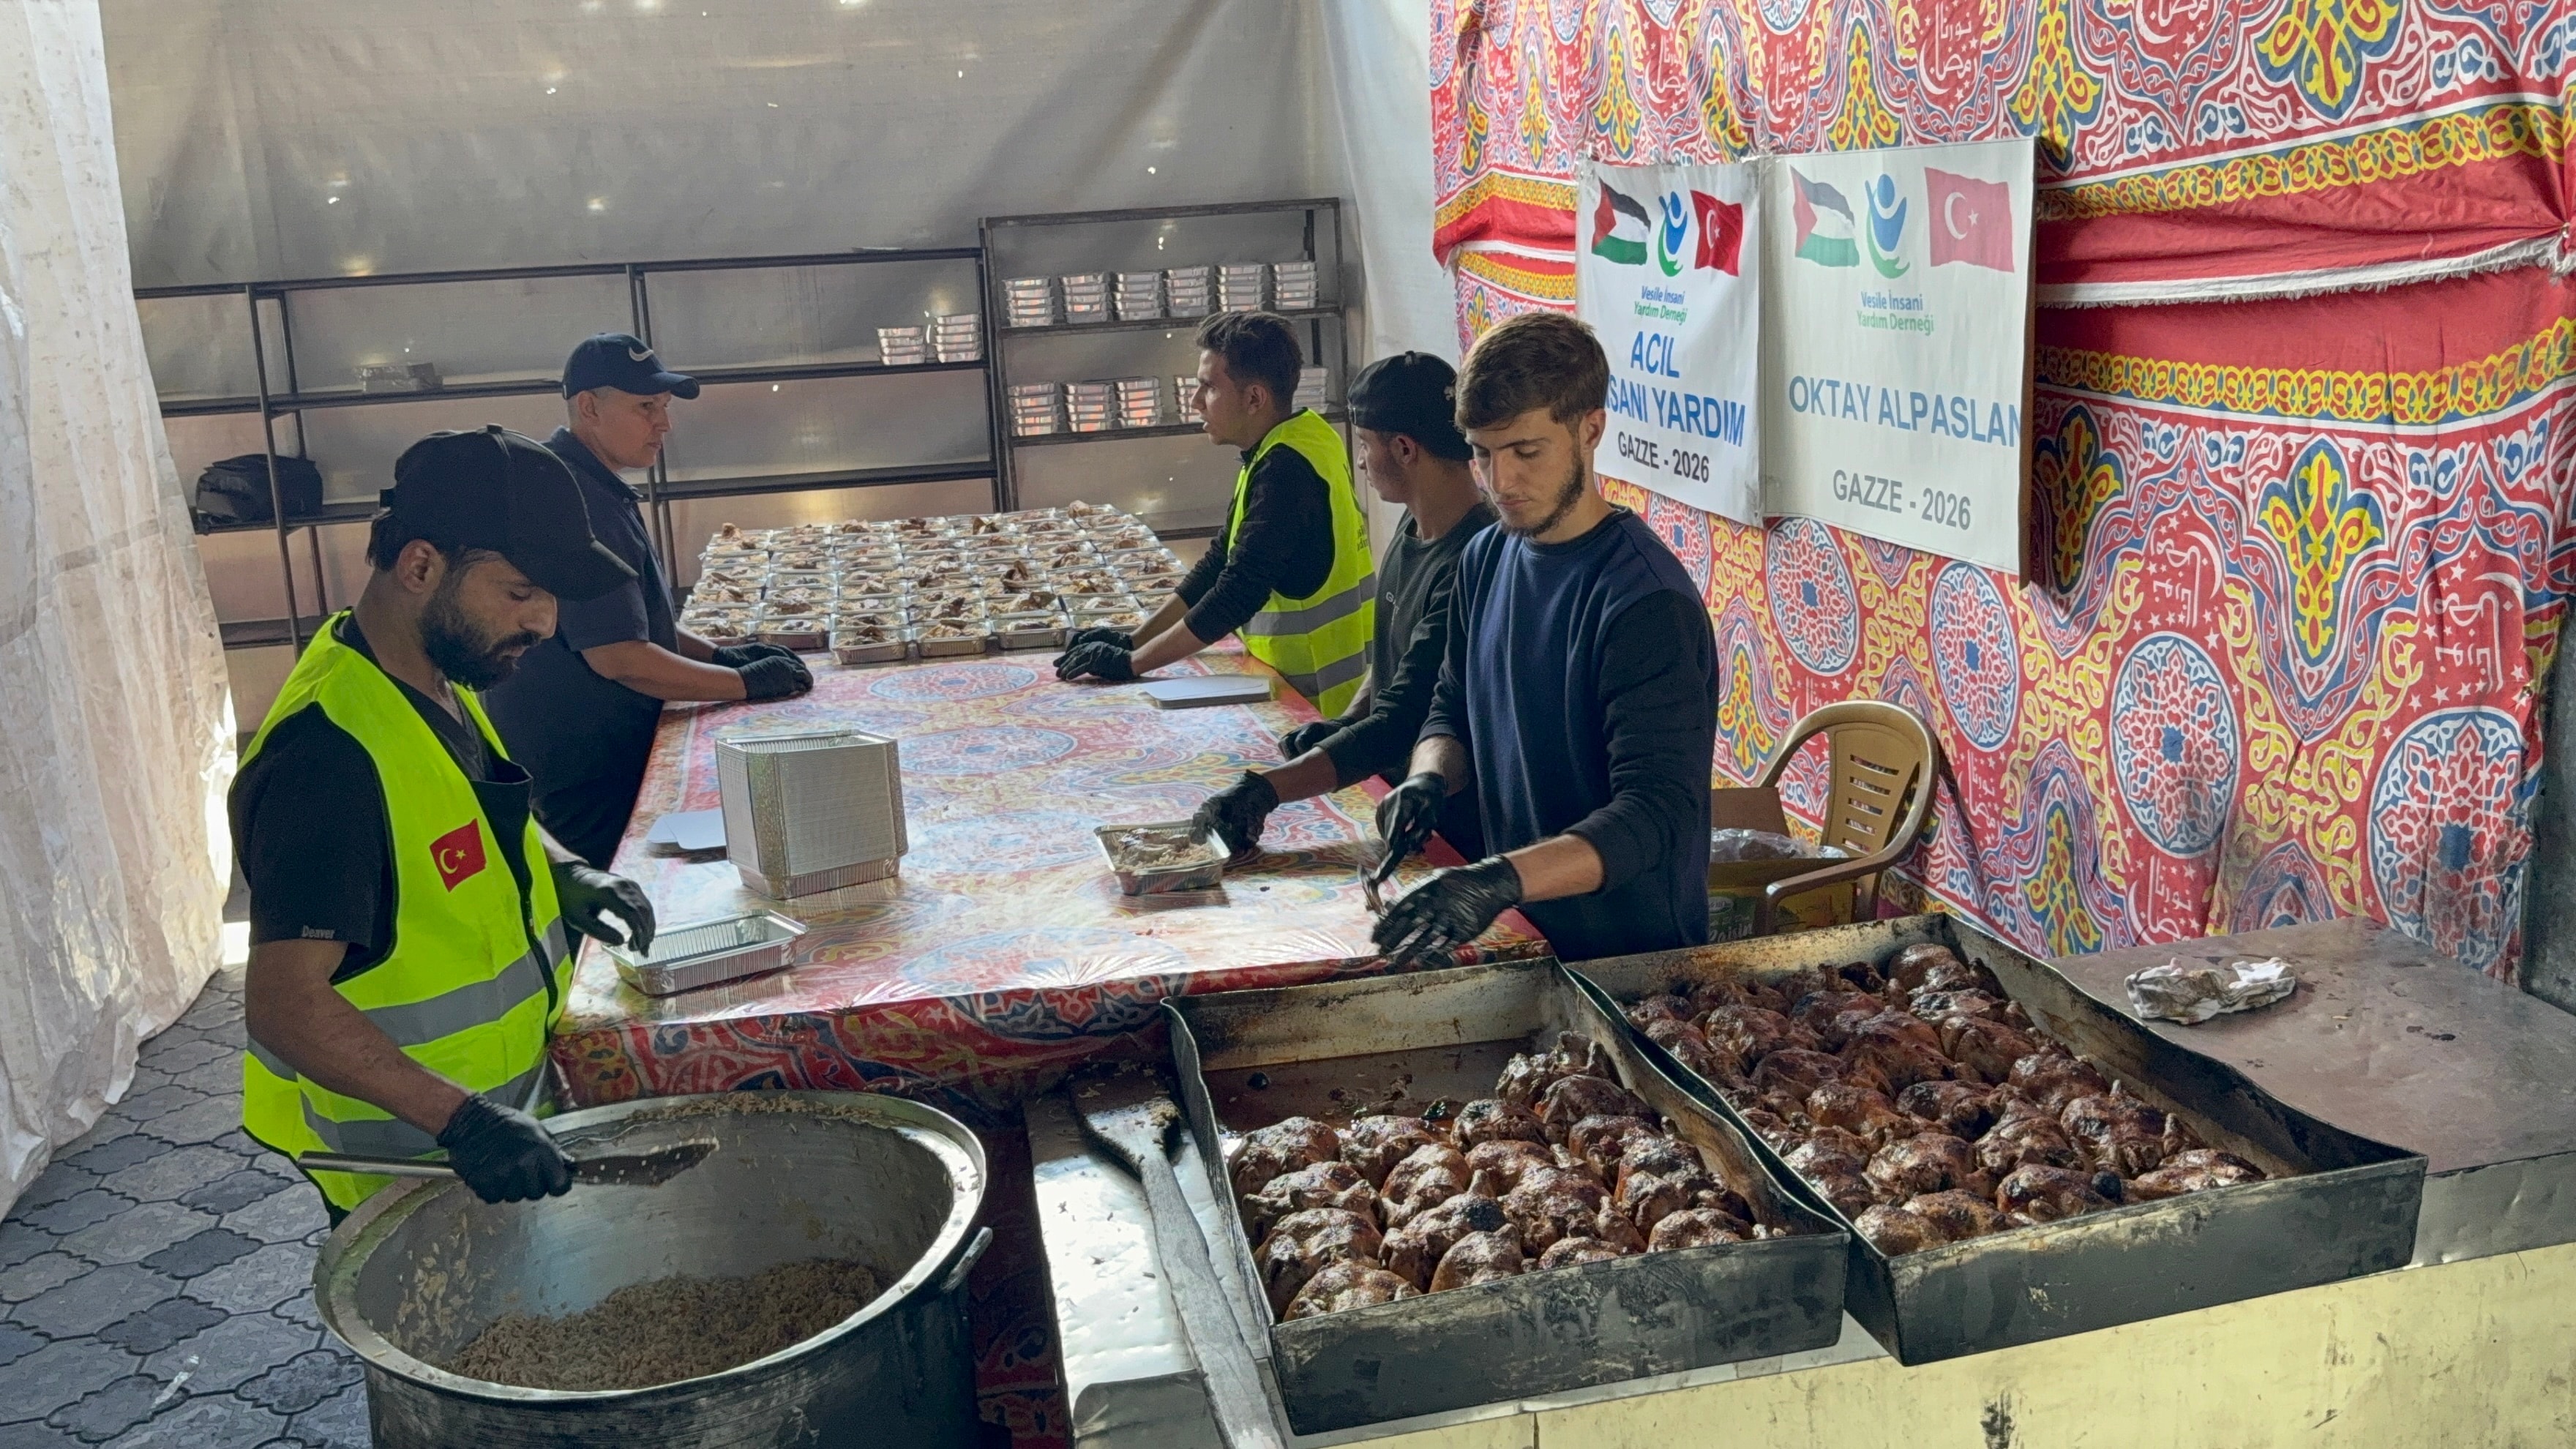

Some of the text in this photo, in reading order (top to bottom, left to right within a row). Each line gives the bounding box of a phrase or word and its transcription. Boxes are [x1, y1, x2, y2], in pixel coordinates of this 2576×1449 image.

[1633, 301, 1688, 326] Yardım Derneği
[1641, 285, 1663, 302] Vesile
[1860, 289, 1923, 311] Vesile İnsani
[1857, 310, 1934, 336] Yardım Derneği
[1630, 331, 1680, 378] ACIL
[1606, 374, 1745, 447] SANI YARDIM
[1789, 375, 2021, 448] OKTAY ALPASLAN
[1618, 431, 1660, 470] GAZZE
[1672, 448, 1710, 483] 2026
[1832, 469, 1903, 514] GAZZE
[1921, 487, 1972, 531] 2026
